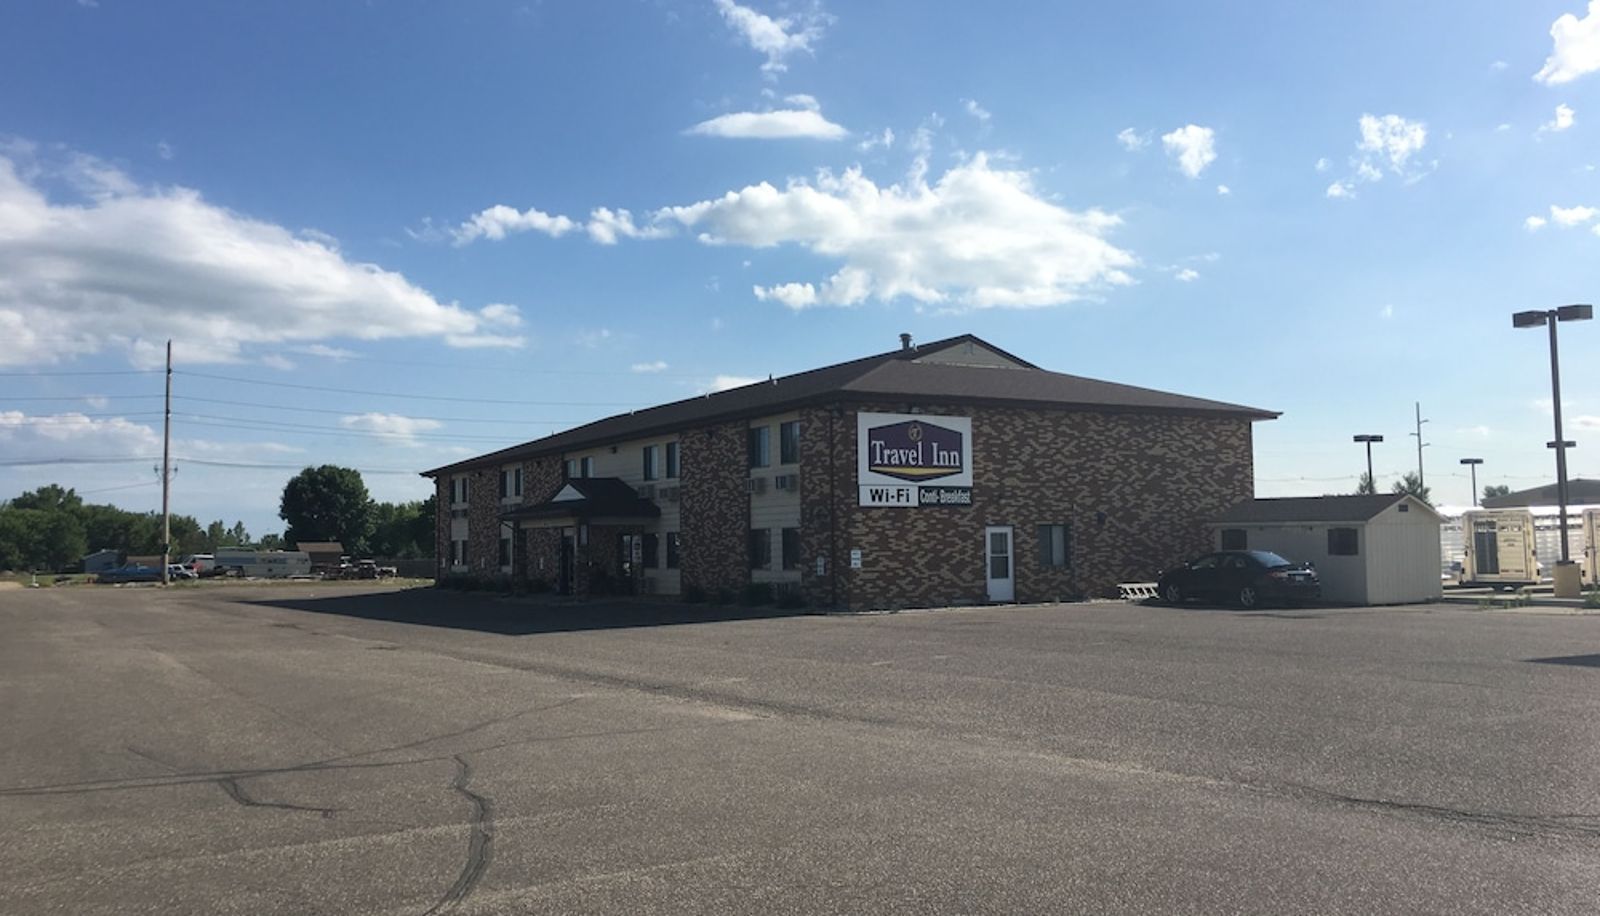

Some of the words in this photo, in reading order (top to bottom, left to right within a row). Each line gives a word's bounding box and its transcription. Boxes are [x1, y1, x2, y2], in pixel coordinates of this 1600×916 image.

[871, 440, 924, 466] Travel
[931, 442, 960, 466] Inn
[869, 488, 910, 503] Wi-Fi
